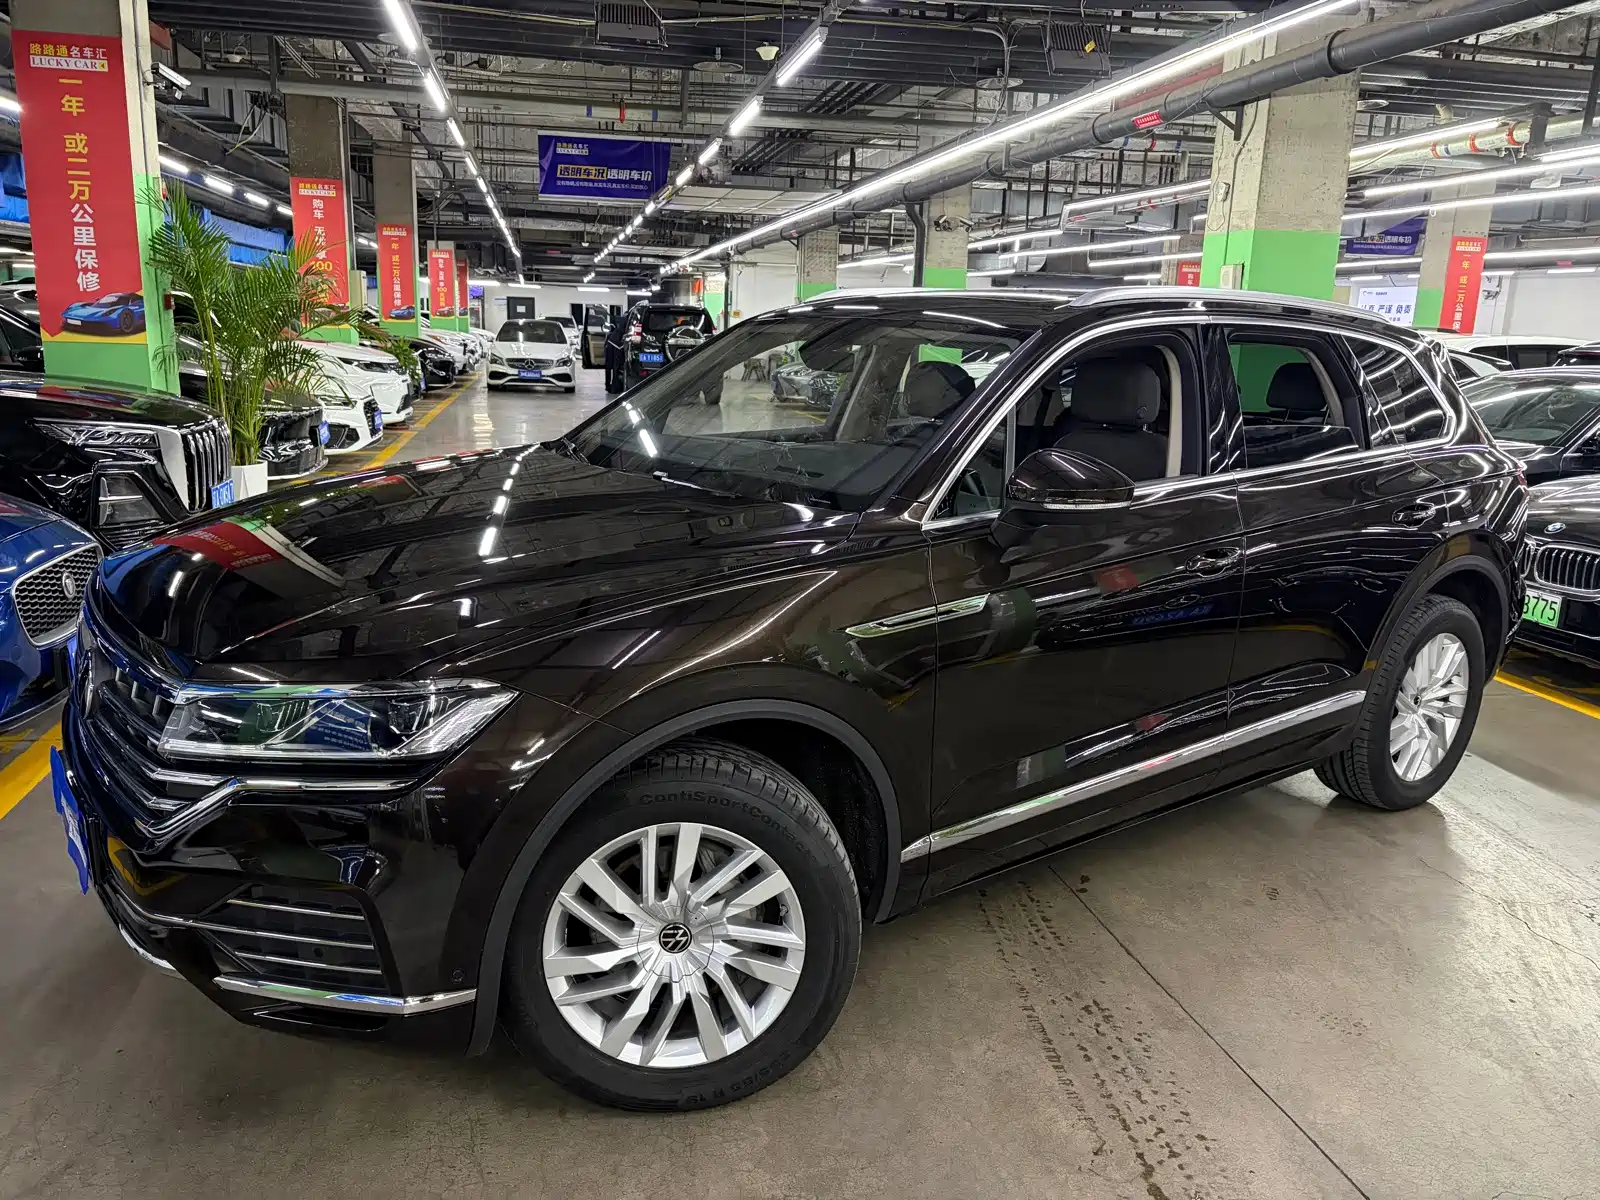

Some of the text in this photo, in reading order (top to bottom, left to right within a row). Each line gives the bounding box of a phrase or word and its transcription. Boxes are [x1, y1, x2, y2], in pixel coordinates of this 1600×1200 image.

[29, 43, 108, 59] 路路通名车汇
[31, 56, 72, 67] LUCKY
[58, 78, 101, 293] 一年 或二万公里保修
